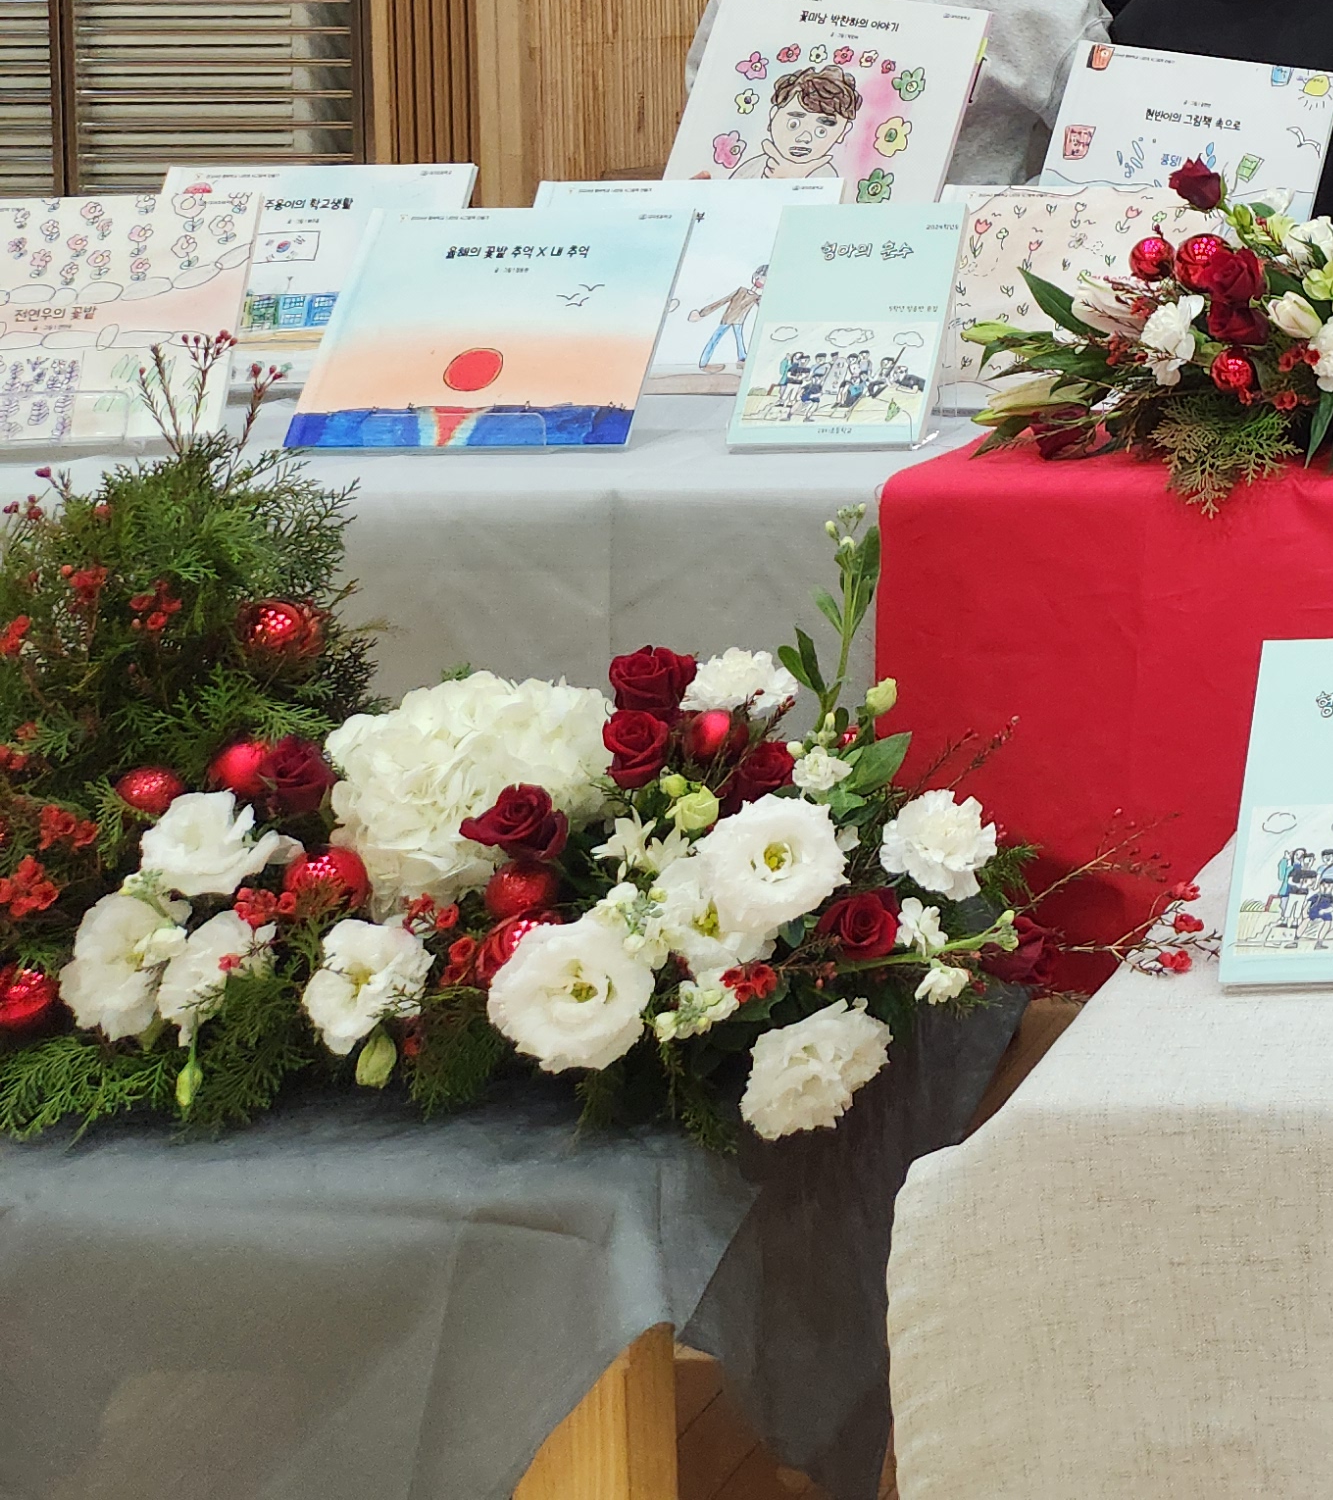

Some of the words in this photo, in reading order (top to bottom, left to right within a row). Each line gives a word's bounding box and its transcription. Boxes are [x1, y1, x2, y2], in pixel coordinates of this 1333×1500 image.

[799, 10, 827, 25] 꽃미남
[871, 21, 899, 32] 이야기
[1183, 113, 1212, 128] 그림책
[1215, 119, 1241, 131] 속으로
[310, 198, 353, 210] 학교생활
[484, 246, 507, 258] 꽃밭
[511, 246, 534, 258] 추억
[550, 246, 563, 257] 내
[567, 245, 590, 258] 추억
[821, 241, 873, 260] 형아의
[14, 307, 66, 322] 전연우의
[70, 306, 98, 320] 꽃밭
